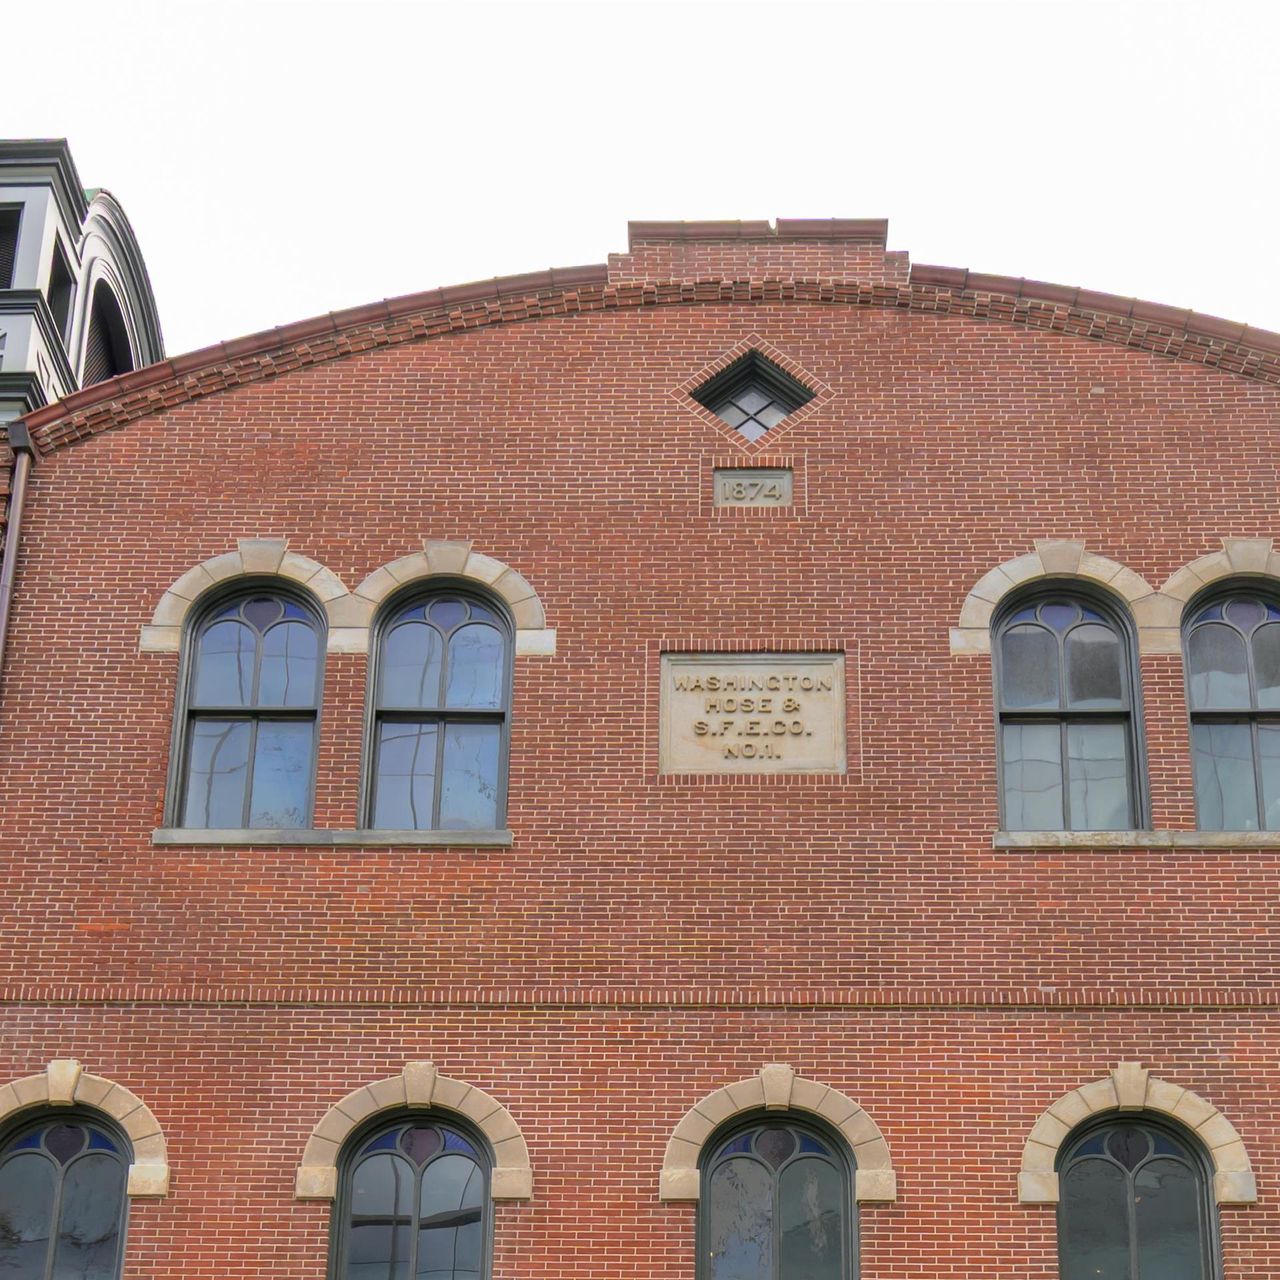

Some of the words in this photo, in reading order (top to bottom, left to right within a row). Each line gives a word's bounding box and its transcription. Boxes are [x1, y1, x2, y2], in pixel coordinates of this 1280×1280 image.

[723, 481, 783, 501] 1874
[673, 675, 833, 692] WASHINGTON
[705, 698, 772, 714] HOSE
[783, 698, 801, 713] &
